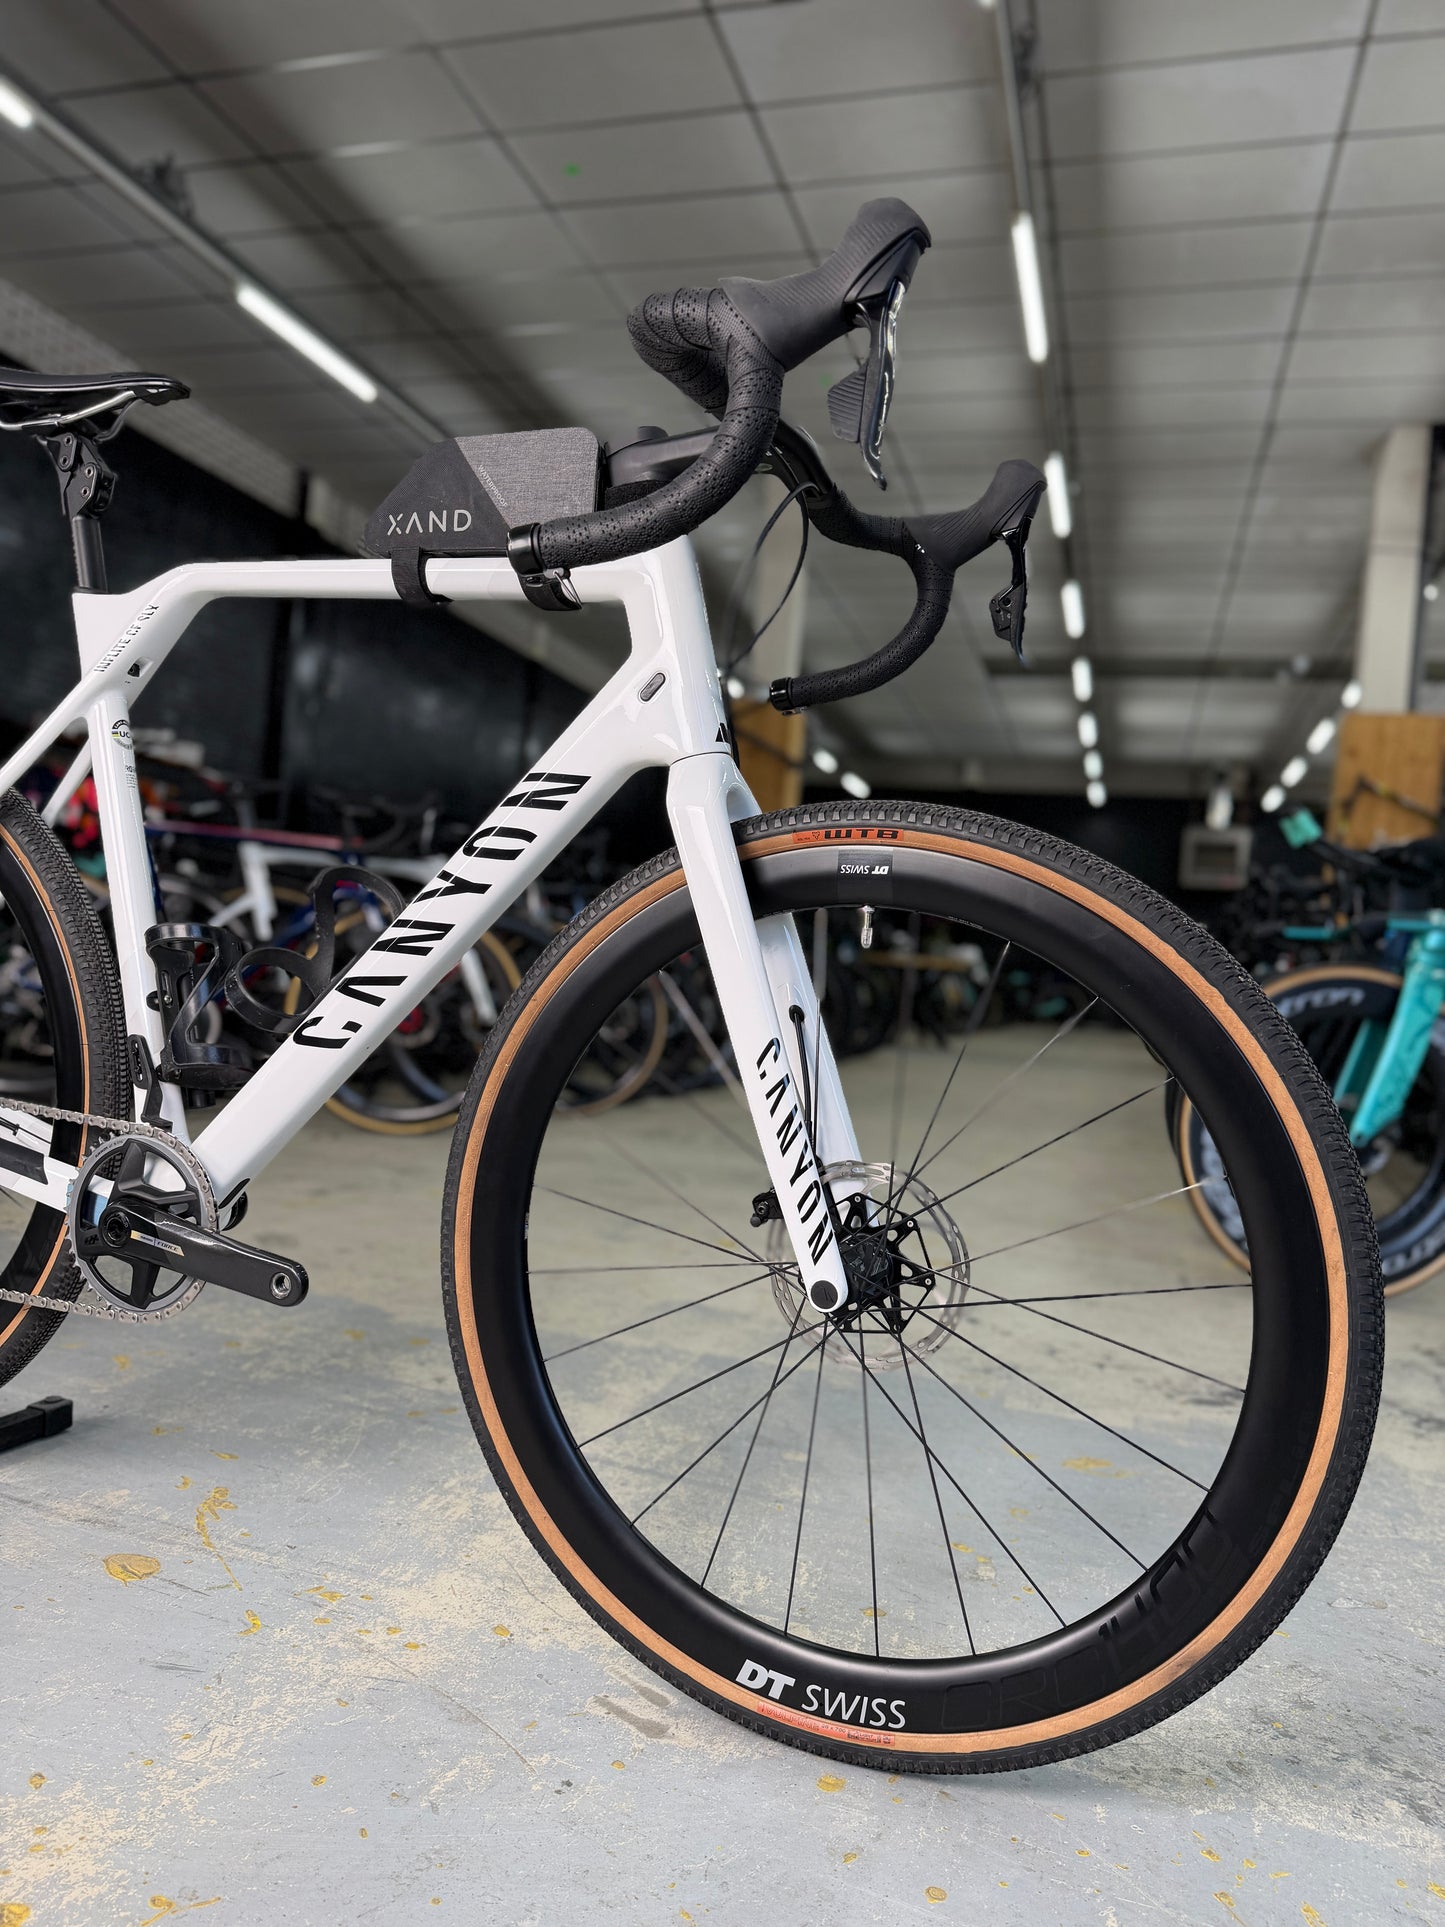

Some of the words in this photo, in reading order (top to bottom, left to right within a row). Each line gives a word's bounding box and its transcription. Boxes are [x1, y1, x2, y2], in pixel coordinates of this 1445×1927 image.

[478, 464, 508, 507] WATERPROOF
[387, 509, 472, 536] XAND
[93, 638, 131, 672] INFLITE
[125, 623, 141, 636] CF
[137, 604, 159, 621] SLX
[824, 828, 899, 840] WTB
[840, 864, 870, 874] SWISS
[871, 865, 890, 875] DT
[292, 772, 592, 1049] CANYON
[756, 1037, 834, 1267] CANYON
[735, 1658, 796, 1700] DT
[801, 1684, 906, 1729] SWISS
